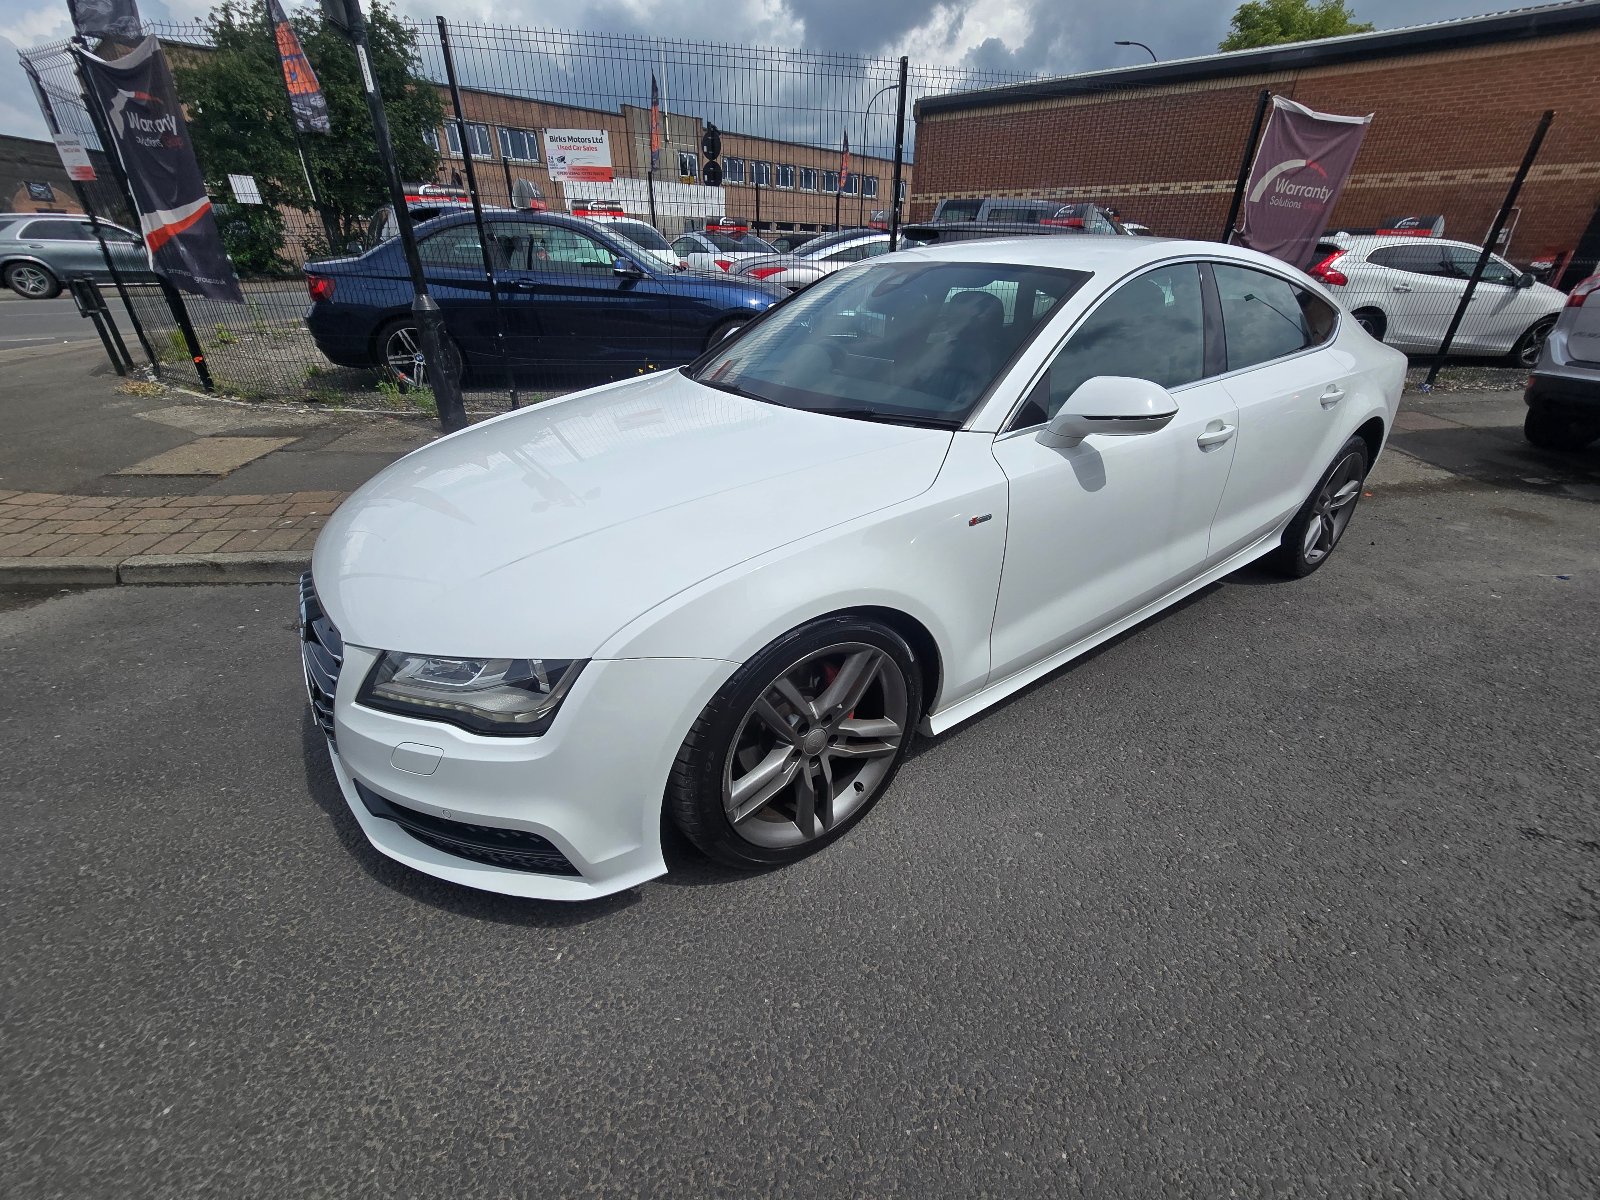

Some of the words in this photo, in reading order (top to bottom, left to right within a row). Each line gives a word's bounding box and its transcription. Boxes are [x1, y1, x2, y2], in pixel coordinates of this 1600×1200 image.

[549, 135, 567, 143] Birks
[567, 136, 592, 144] Motors
[592, 136, 604, 144] Ltd
[1275, 178, 1334, 204] Warranty
[1269, 195, 1302, 209] Solutions
